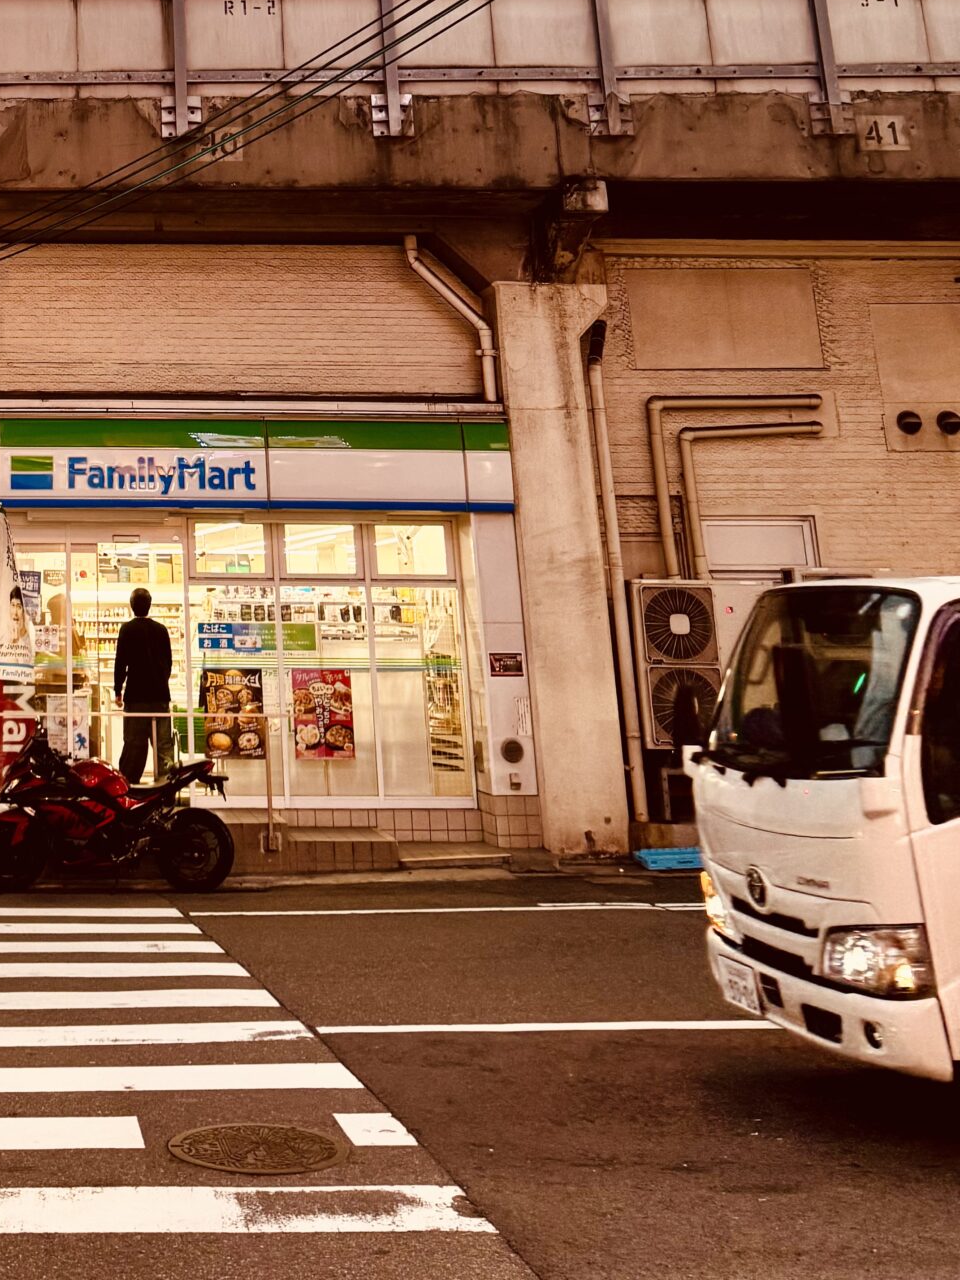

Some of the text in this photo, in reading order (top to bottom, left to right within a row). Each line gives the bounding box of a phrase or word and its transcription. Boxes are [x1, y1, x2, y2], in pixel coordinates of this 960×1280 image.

[224, 0, 275, 15] R1-2
[864, 120, 899, 145] 41
[67, 456, 256, 495] FamilyMart
[202, 624, 228, 633] たばこ
